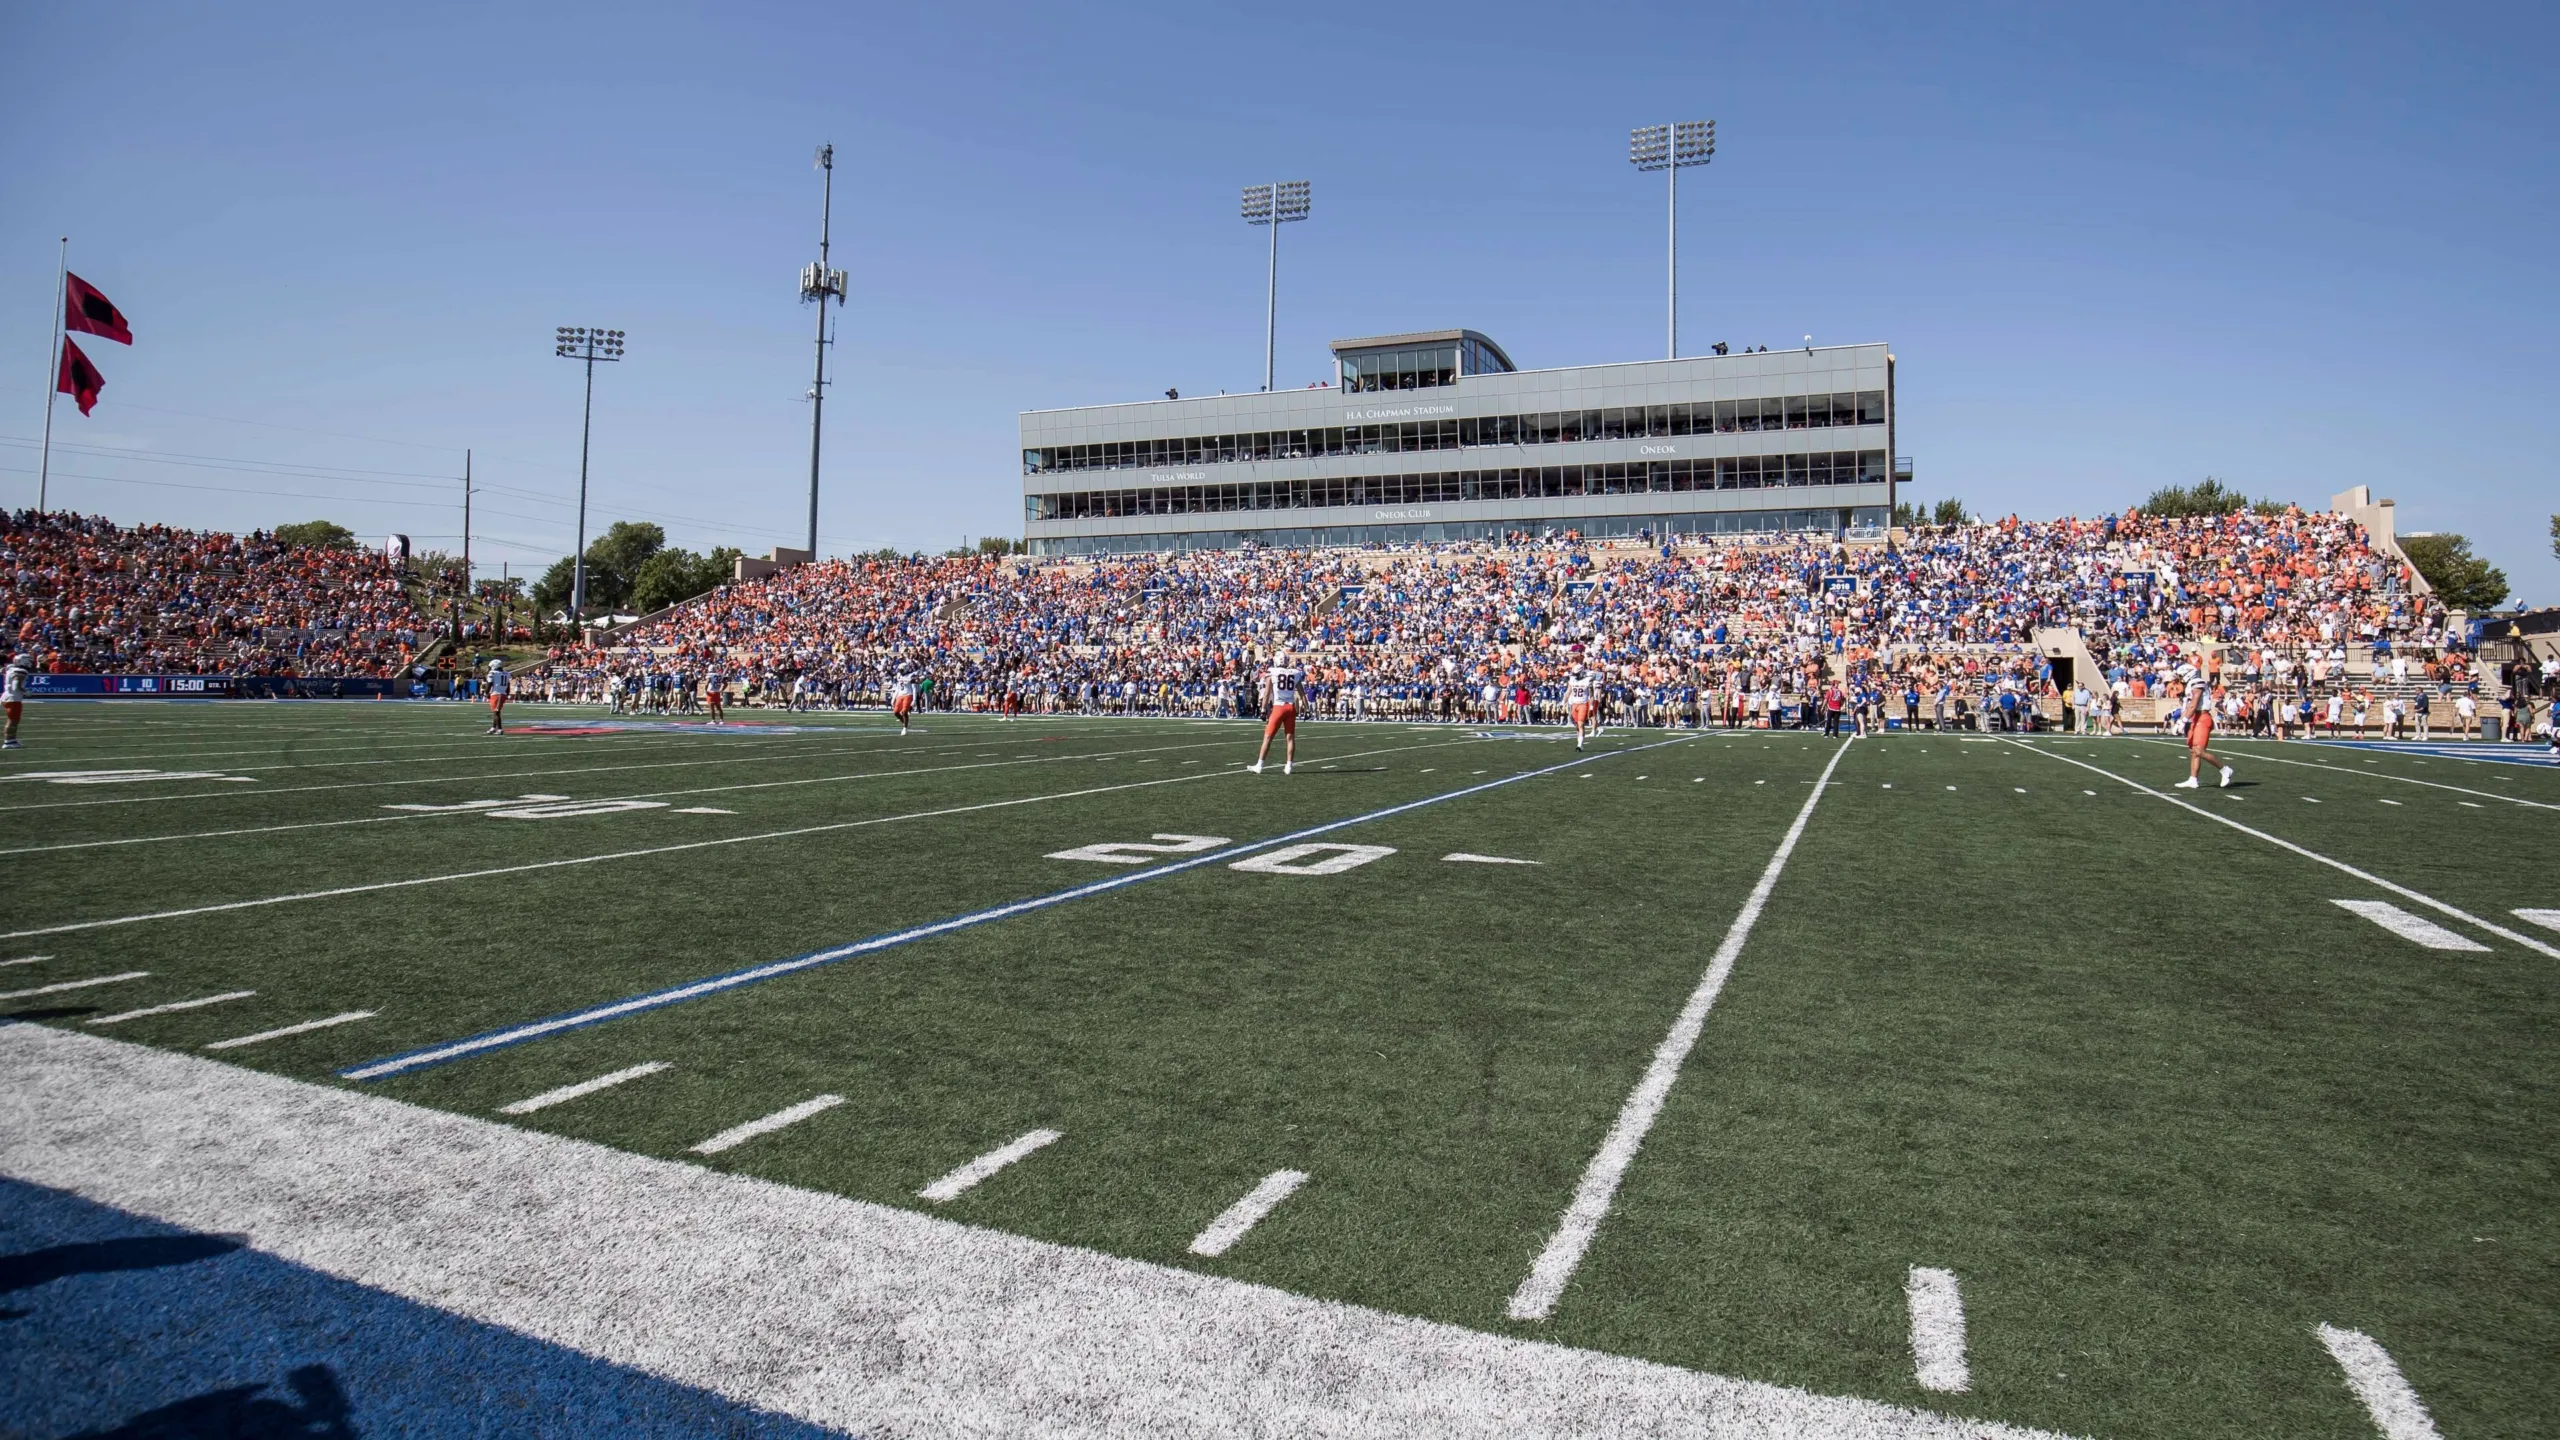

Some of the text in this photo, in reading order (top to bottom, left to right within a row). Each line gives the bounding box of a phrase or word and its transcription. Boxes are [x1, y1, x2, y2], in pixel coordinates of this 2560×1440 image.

[1346, 405, 1454, 420] H.A. CHAPMAN STADIUM
[1640, 445, 1676, 454] ONEOK
[1151, 472, 1205, 482] TULSA WORLD
[1375, 509, 1431, 520] ONEOK CLUB
[438, 657, 456, 670] 25
[142, 678, 153, 688] 10
[170, 679, 205, 691] 15:00
[501, 675, 507, 686] 11
[1278, 674, 1295, 691] 86
[1042, 833, 1397, 875] 20
